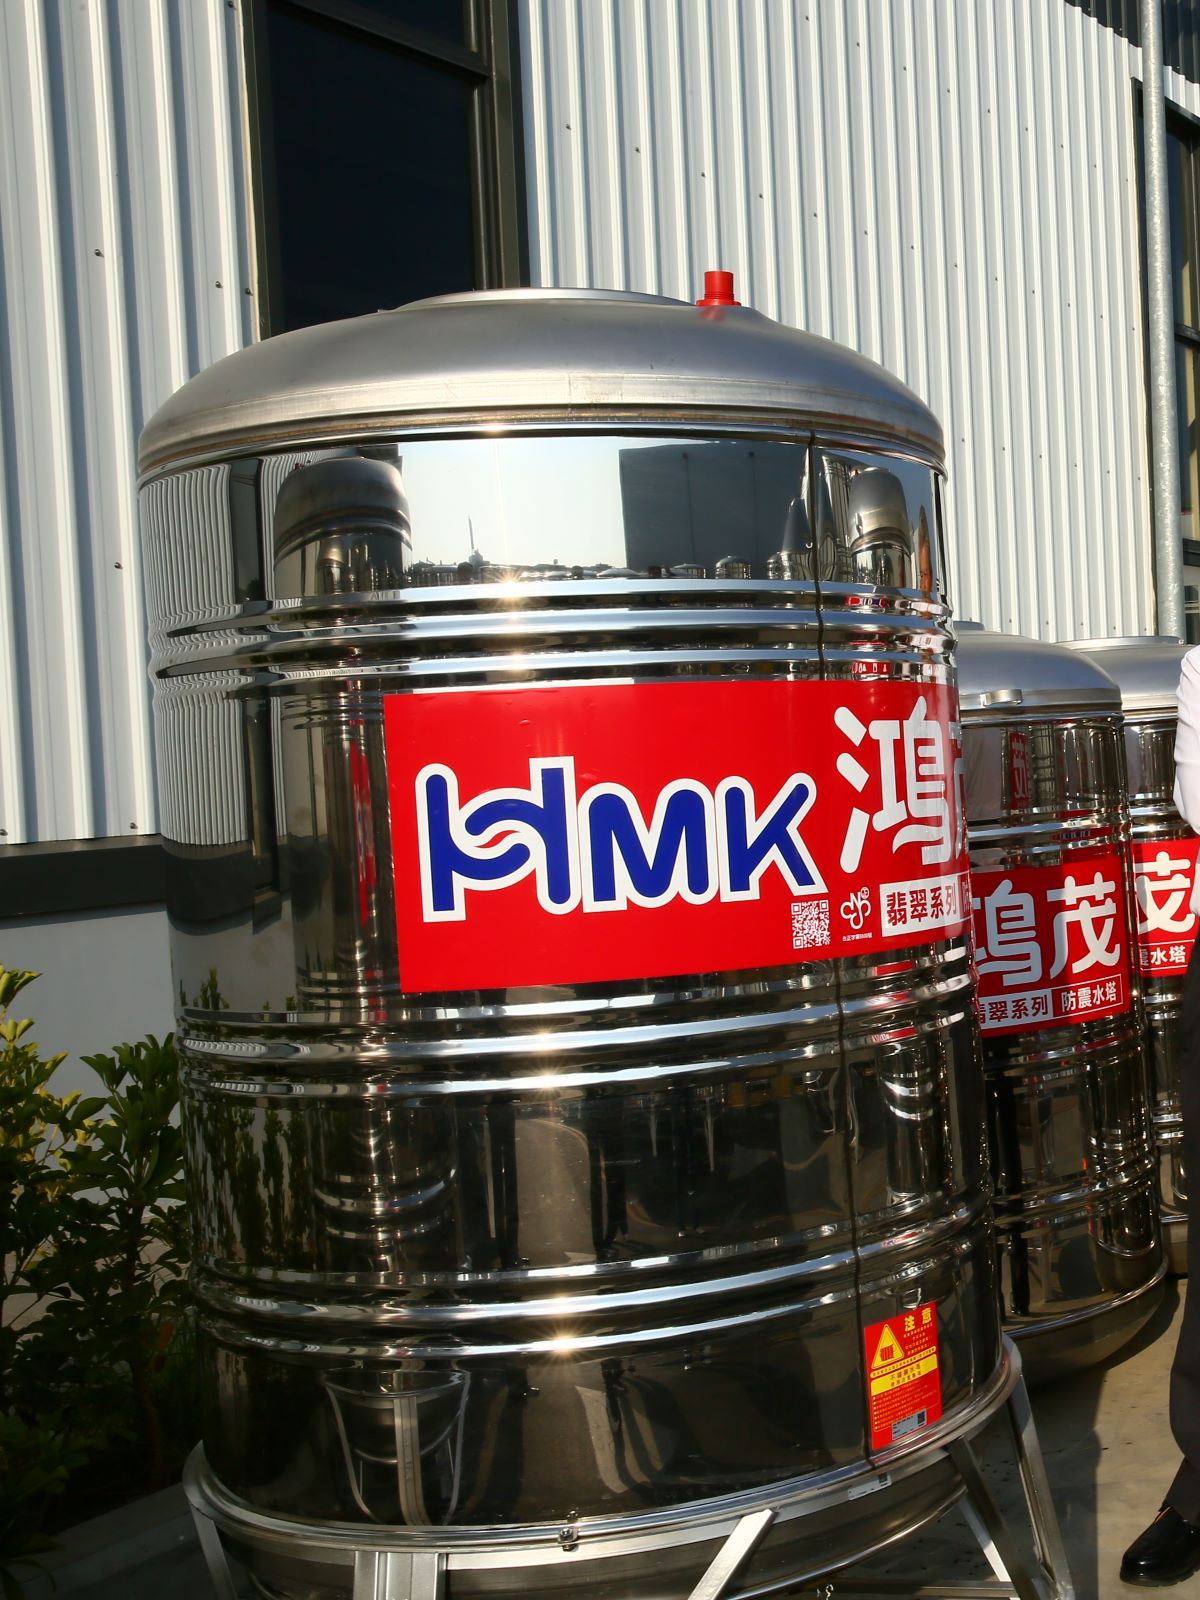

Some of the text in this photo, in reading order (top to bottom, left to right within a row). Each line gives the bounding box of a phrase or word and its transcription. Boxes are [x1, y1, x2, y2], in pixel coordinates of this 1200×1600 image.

[415, 756, 829, 922] HMK
[886, 886, 957, 927] 翡翠系列
[1061, 981, 1117, 1012] 防震水塔
[904, 1307, 932, 1332] 注意
